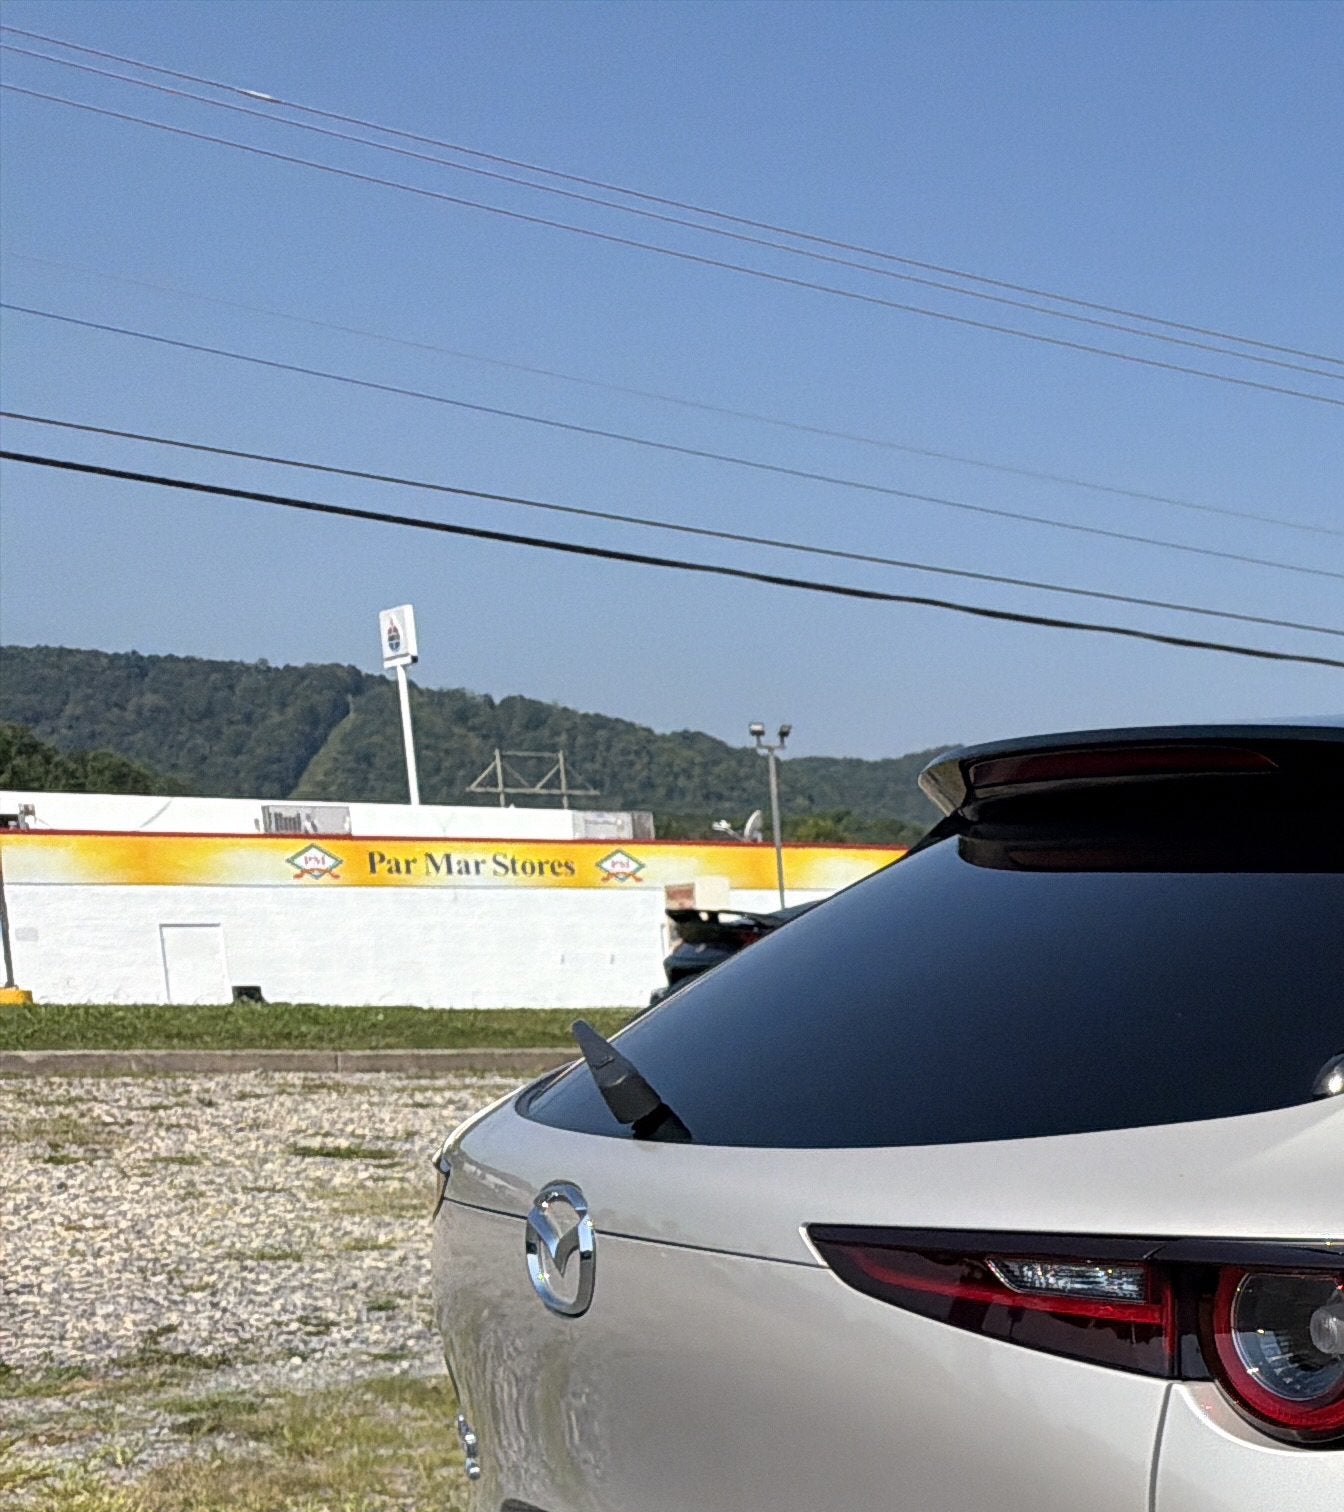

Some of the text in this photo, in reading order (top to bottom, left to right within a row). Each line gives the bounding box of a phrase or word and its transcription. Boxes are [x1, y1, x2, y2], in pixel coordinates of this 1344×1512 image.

[367, 850, 576, 878] Par Mar Stores
